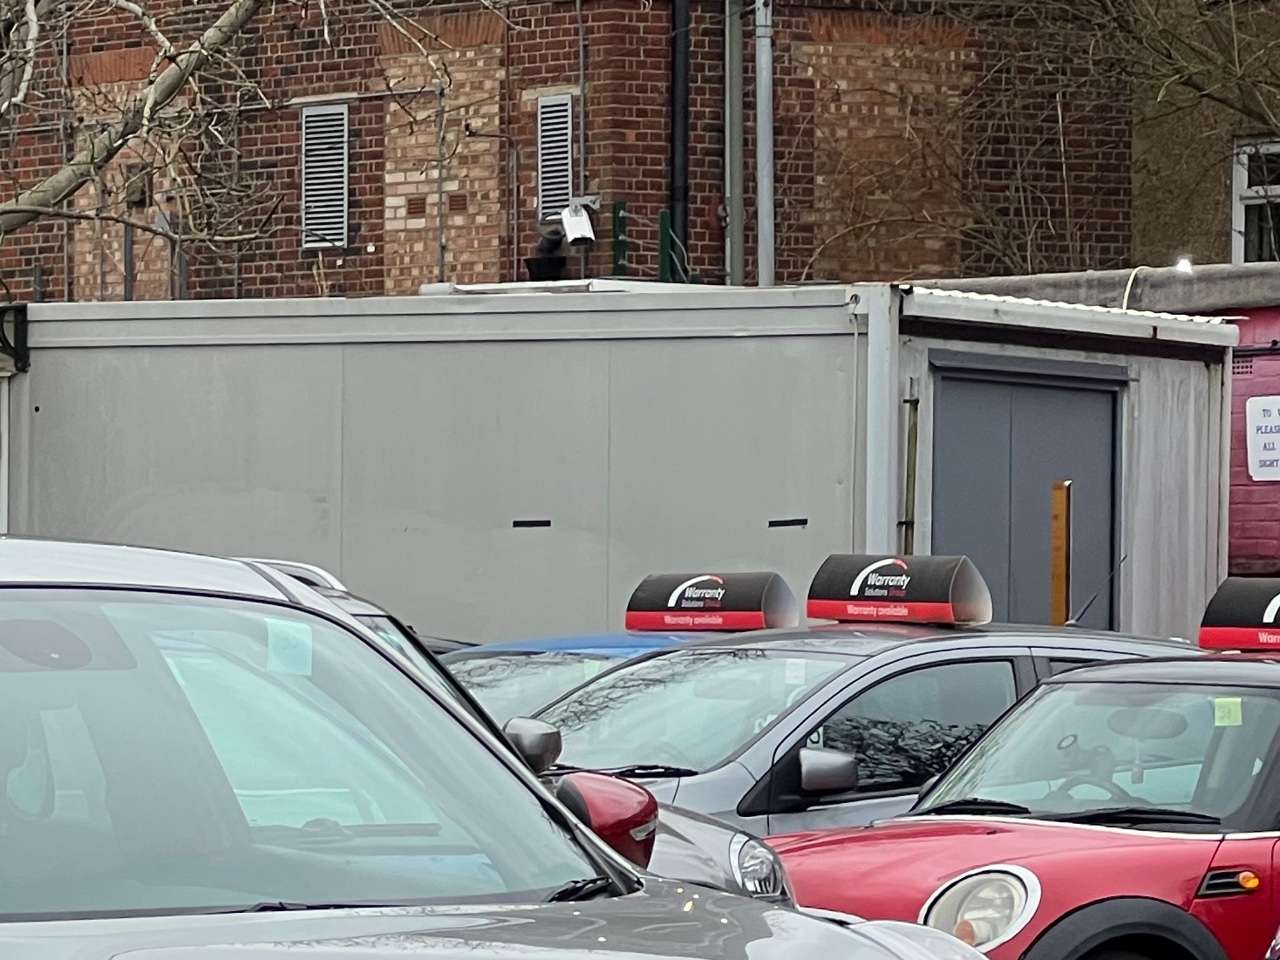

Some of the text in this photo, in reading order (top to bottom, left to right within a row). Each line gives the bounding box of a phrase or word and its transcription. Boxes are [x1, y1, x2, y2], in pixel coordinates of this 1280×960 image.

[866, 573, 910, 589] Warranty
[684, 587, 725, 600] Warranty
[847, 605, 909, 616] Warranty available
